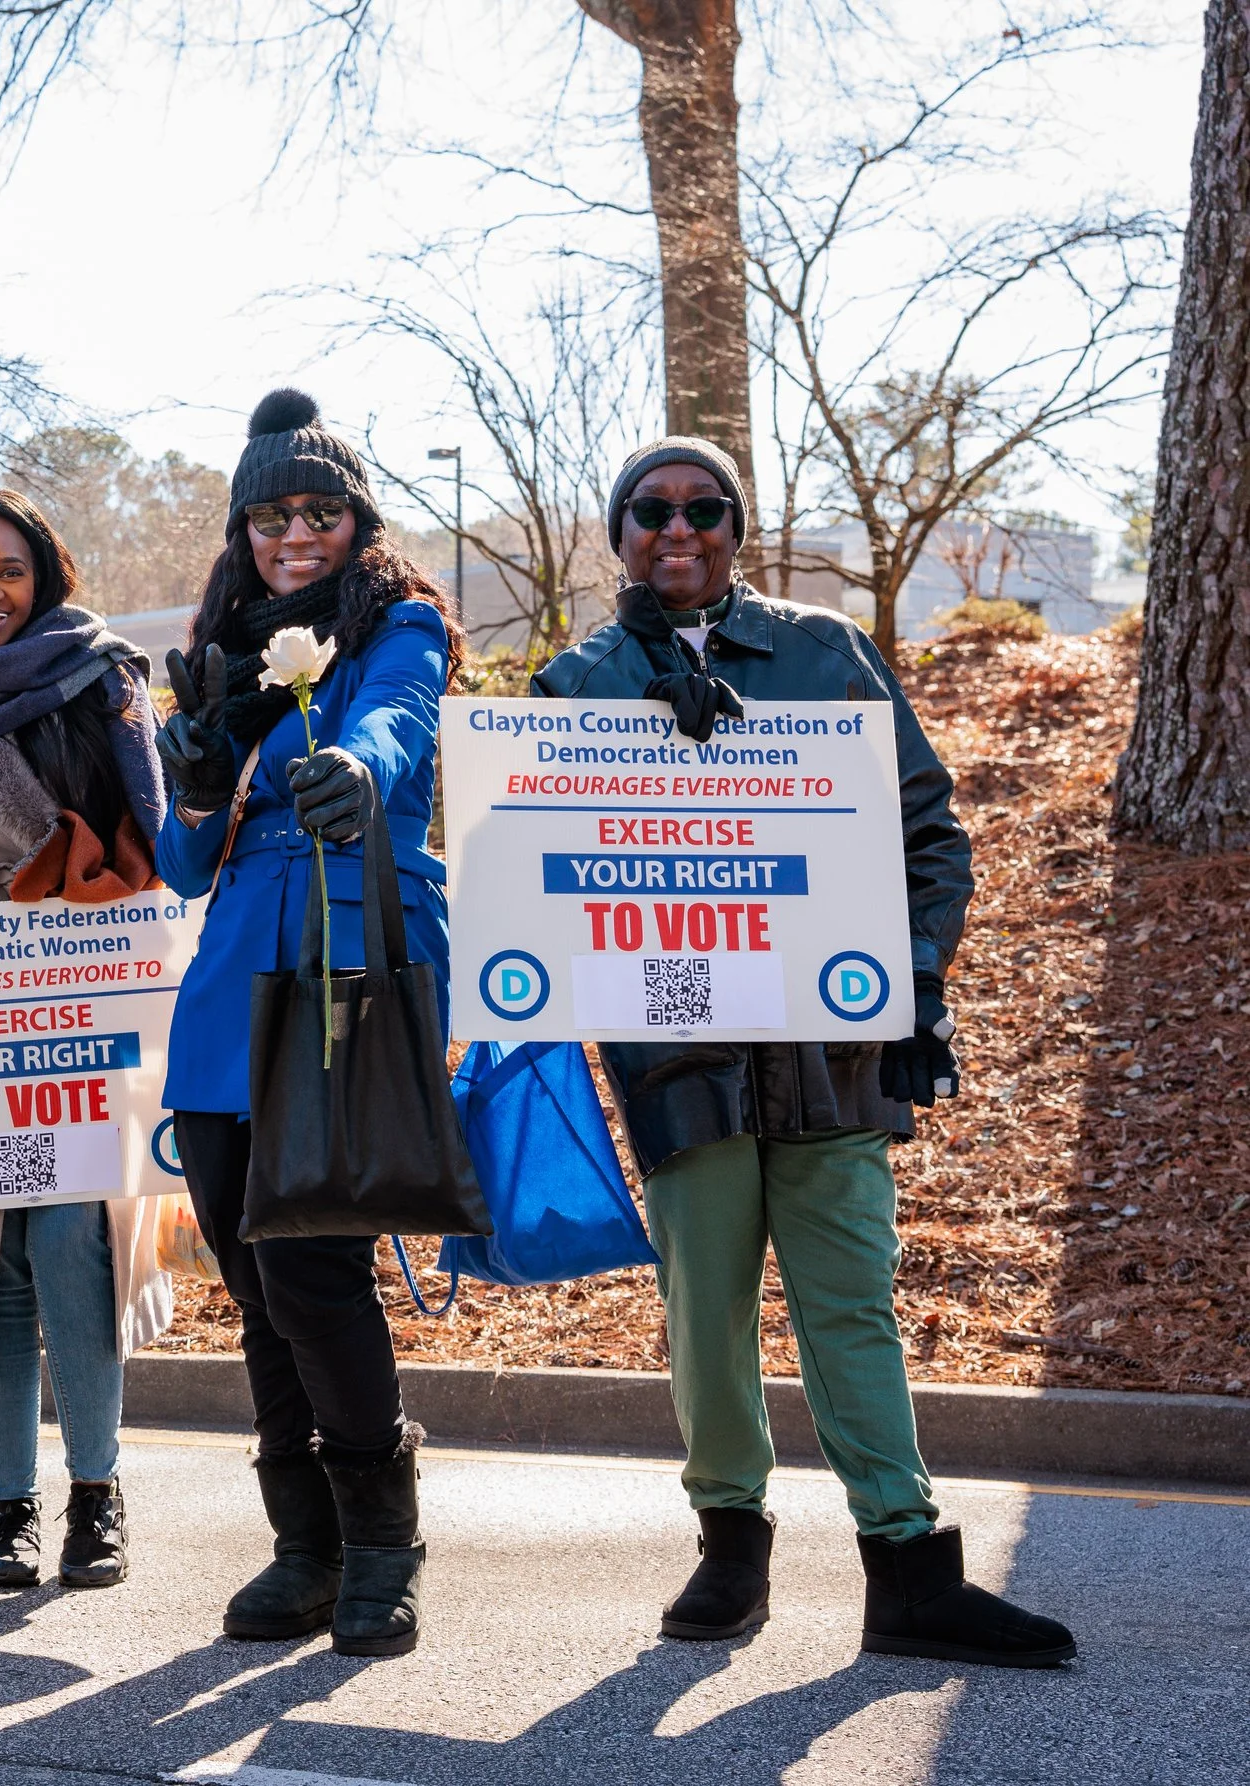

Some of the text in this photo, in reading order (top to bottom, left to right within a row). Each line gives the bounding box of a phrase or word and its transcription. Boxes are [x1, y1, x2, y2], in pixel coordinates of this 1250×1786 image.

[469, 709, 863, 739] Clayton County deration of
[537, 742, 798, 765] Democratic Women
[507, 775, 833, 797] ENCOURAGES EVERYONE TO
[599, 819, 754, 846] EXERCISE
[570, 860, 777, 889] YOUR RIGHT
[28, 903, 157, 931] Federation
[164, 900, 187, 920] of
[584, 902, 771, 952] TO VOTE
[40, 937, 131, 955] Women
[19, 964, 127, 988] EVERYONE
[134, 960, 162, 978] TO
[502, 969, 530, 1001] D
[840, 971, 870, 1002] D
[24, 1039, 114, 1070] RIGHT
[5, 1078, 109, 1128] VOTE
